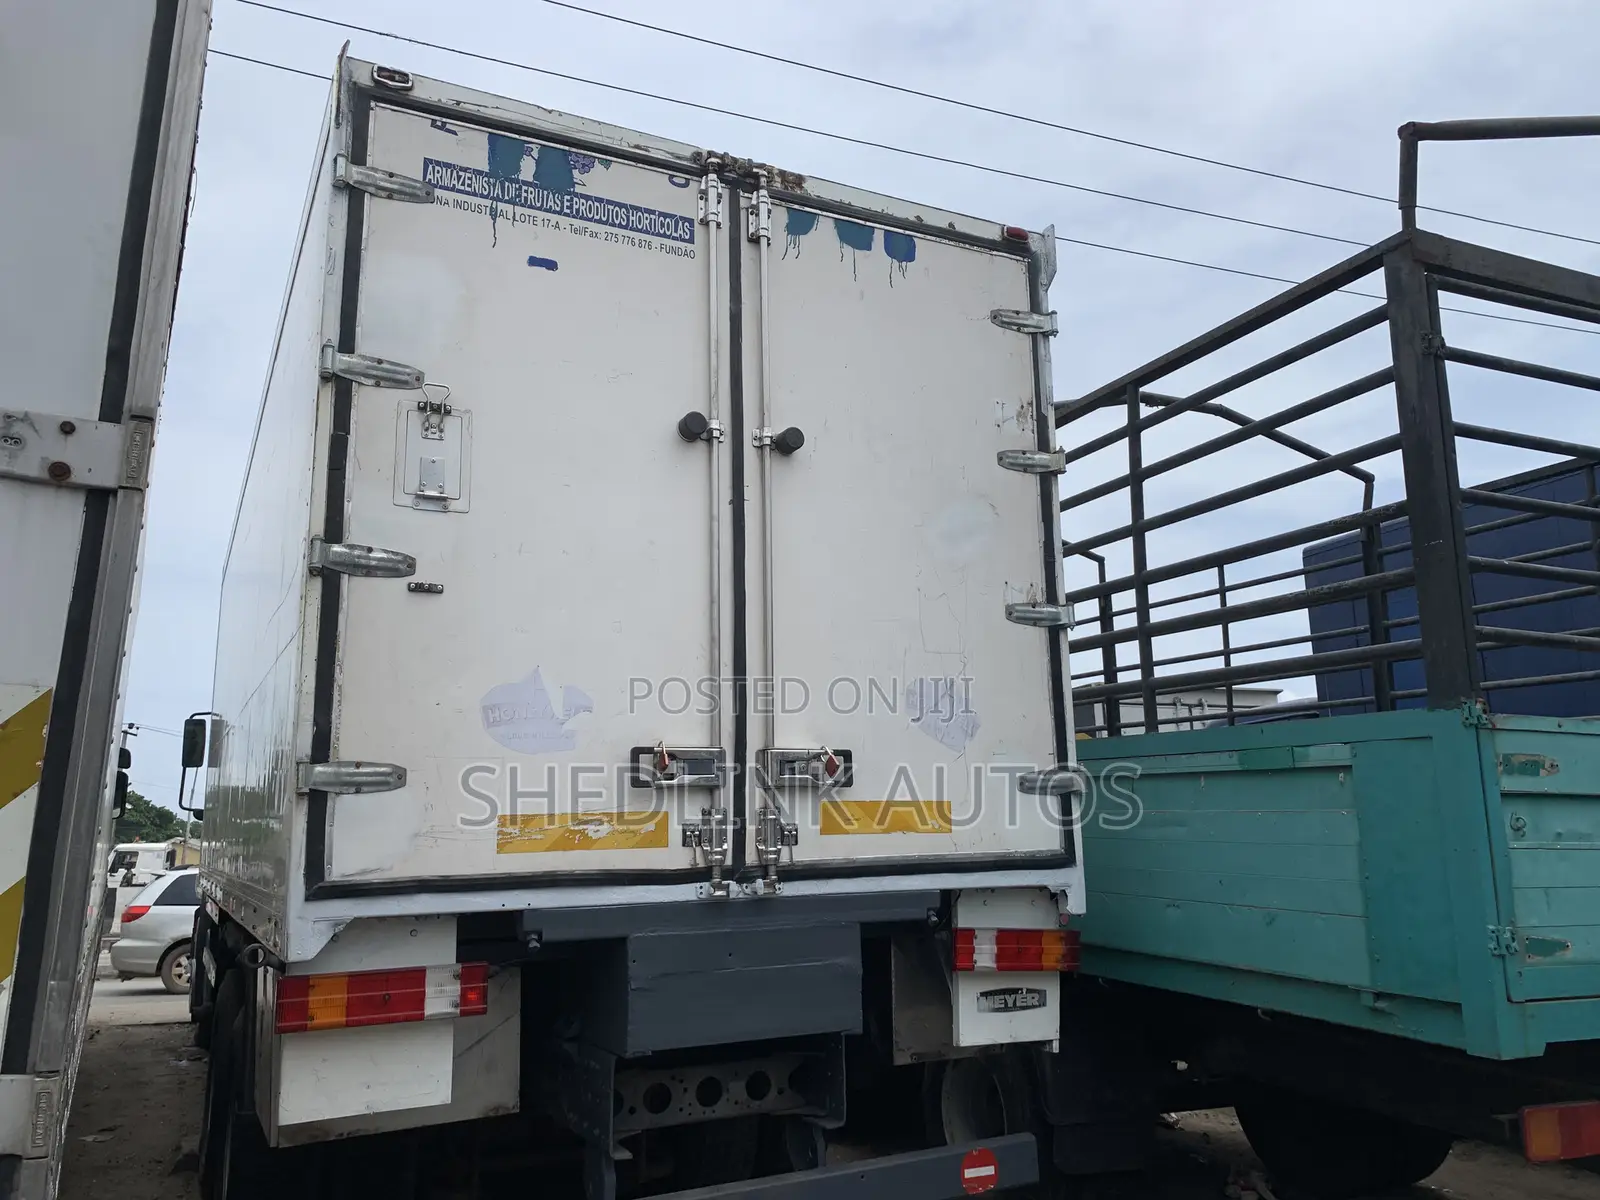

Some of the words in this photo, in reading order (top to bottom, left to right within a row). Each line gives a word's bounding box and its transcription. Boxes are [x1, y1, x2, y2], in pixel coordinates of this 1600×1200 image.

[513, 212, 538, 226] LOTE
[541, 218, 561, 231] 17-A
[569, 223, 602, 240] Tel/Fax:
[604, 231, 619, 244] 275
[621, 235, 636, 247] 776
[638, 239, 653, 251] 876
[660, 243, 696, 259] FUNDÃO
[564, 195, 571, 213] E
[573, 197, 627, 226] PRODUTOS
[629, 209, 690, 240] HORTÍCOLAS
[978, 992, 1040, 1010] MEYER
